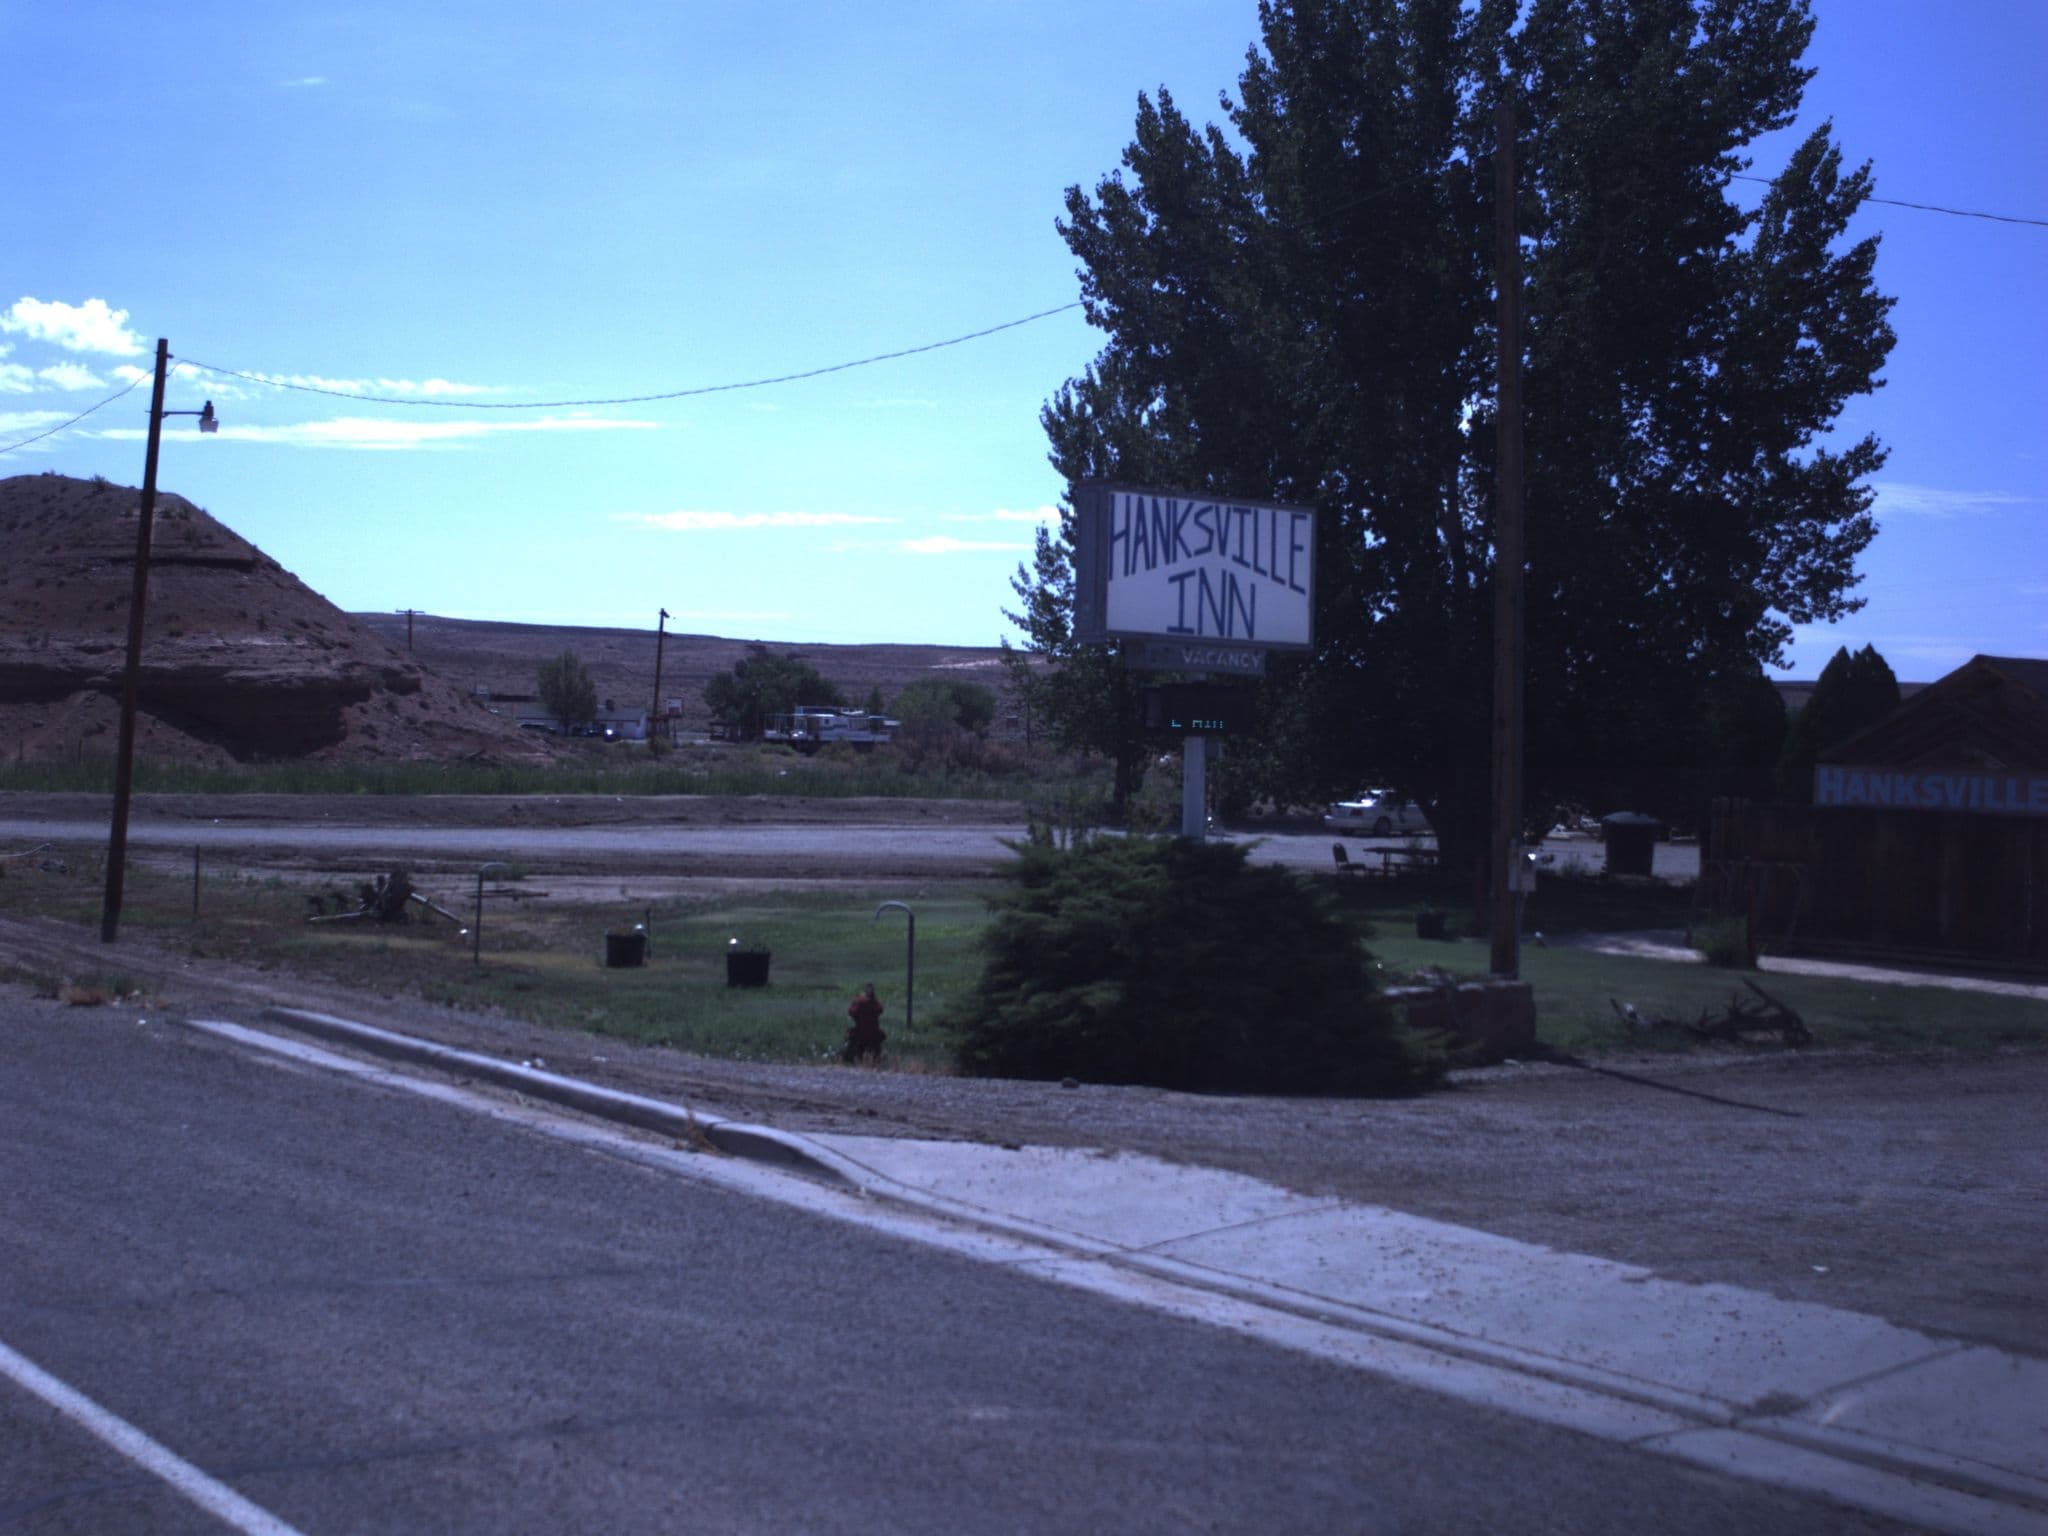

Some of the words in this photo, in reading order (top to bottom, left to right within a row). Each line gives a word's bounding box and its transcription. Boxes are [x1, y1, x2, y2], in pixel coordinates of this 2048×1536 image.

[1109, 493, 1308, 596] HANKSVILLE
[1166, 566, 1256, 639] INN
[1180, 649, 1261, 669] VACANCY
[1818, 766, 2048, 811] HANKSVILLE
